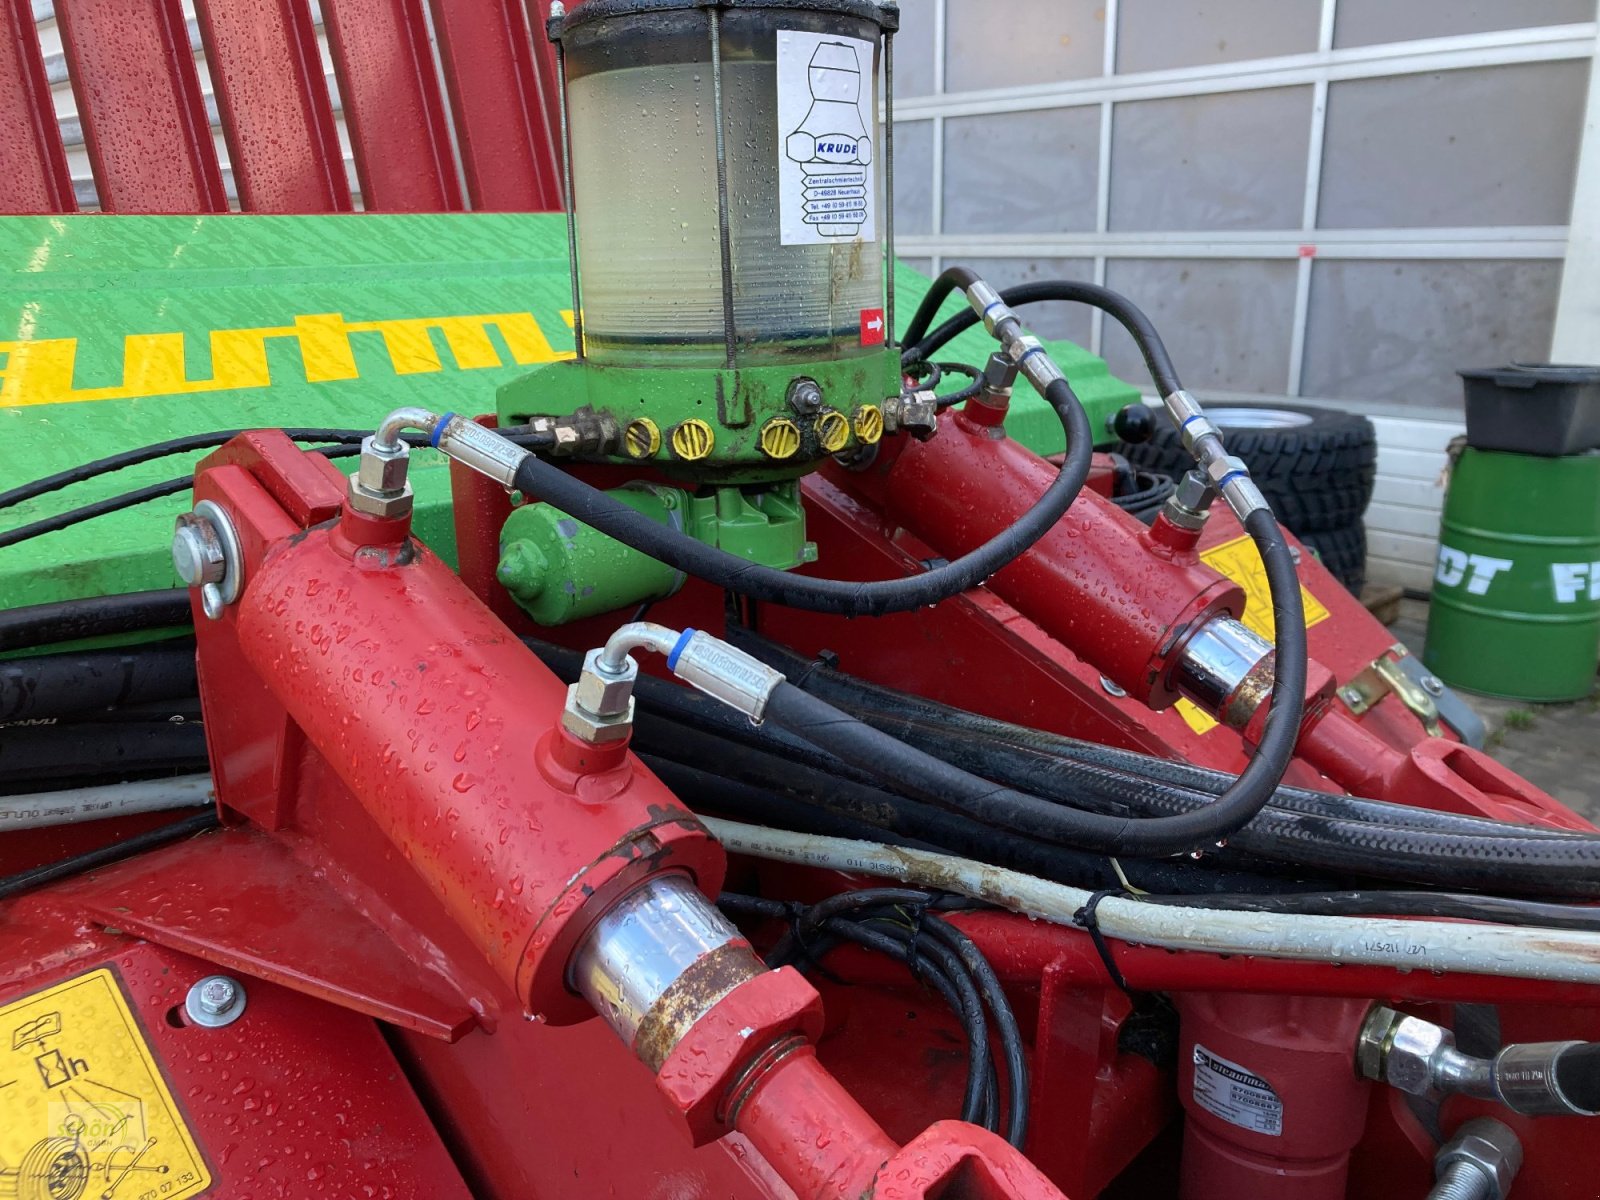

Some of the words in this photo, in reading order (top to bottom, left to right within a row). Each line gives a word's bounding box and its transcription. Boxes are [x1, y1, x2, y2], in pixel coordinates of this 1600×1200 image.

[817, 143, 857, 154] KRUDE
[869, 861, 907, 875] CLASSIC
[67, 1057, 90, 1077] h
[160, 1181, 173, 1194] 07
[176, 1171, 195, 1187] 133
